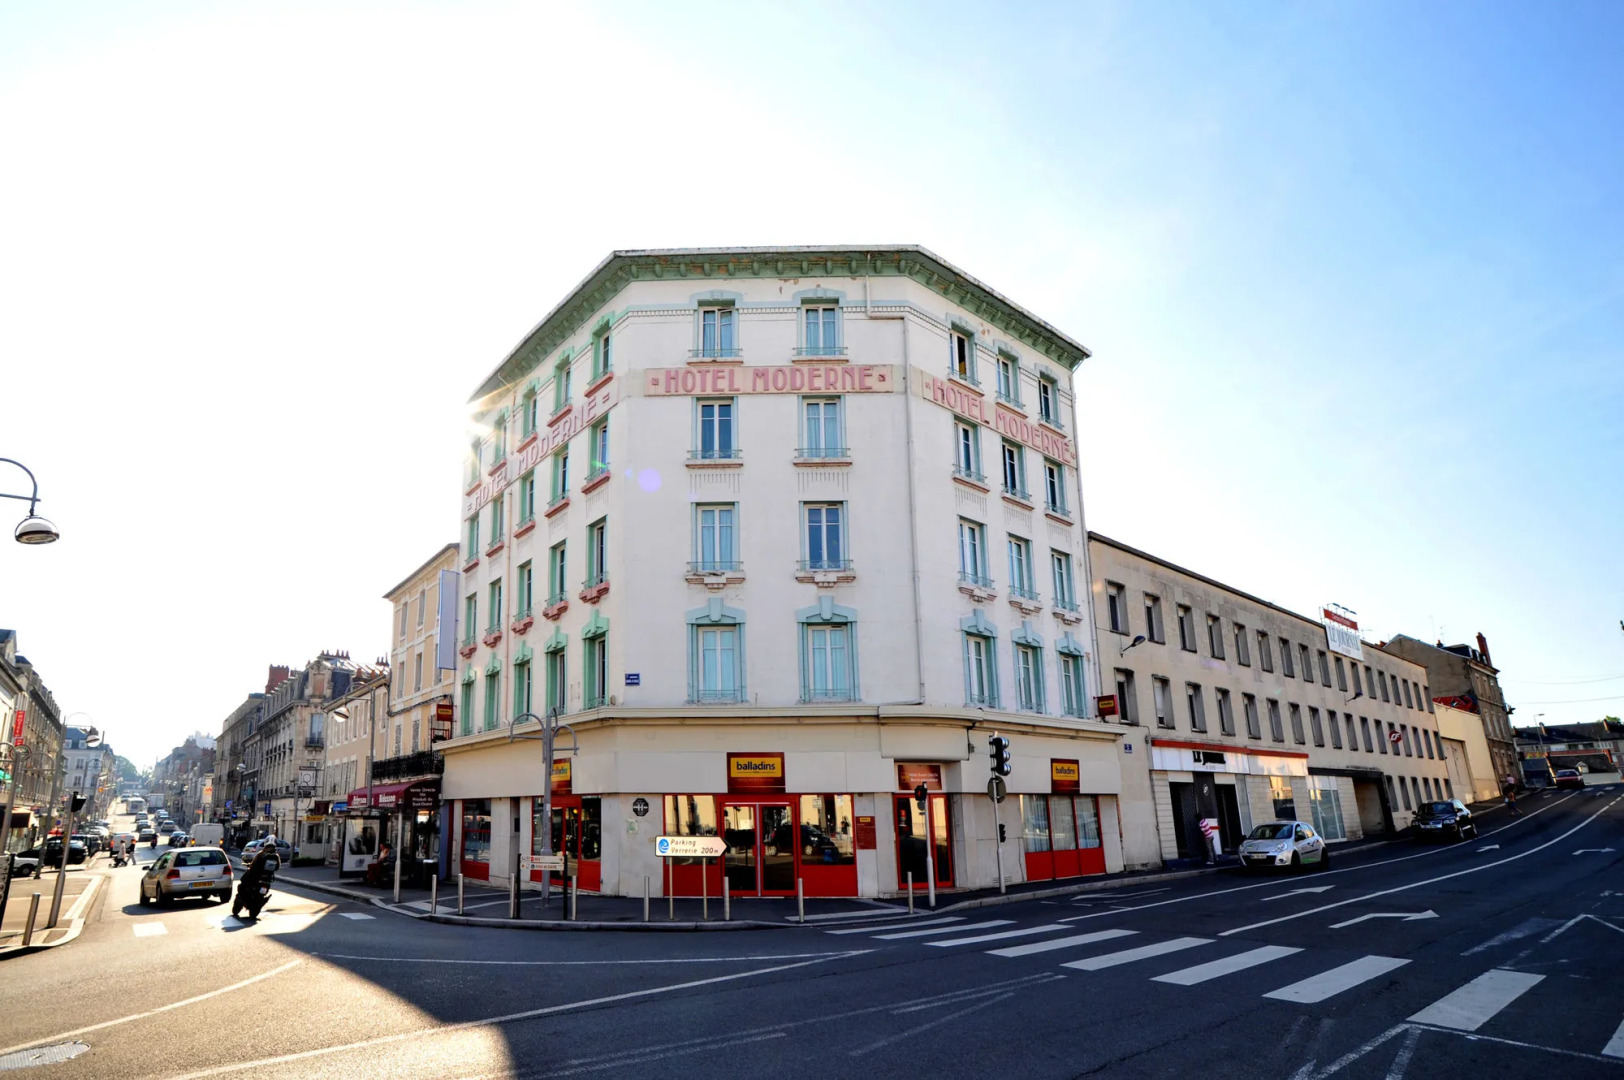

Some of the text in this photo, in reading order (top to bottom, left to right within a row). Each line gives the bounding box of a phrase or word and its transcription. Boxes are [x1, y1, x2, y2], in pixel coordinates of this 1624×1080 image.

[664, 365, 873, 393] HOTEL MODERNE
[932, 377, 1072, 464] HOTEL MODERNE
[517, 396, 597, 476] MODERNE
[736, 760, 776, 771] balladins
[1055, 765, 1076, 775] balladins
[670, 838, 697, 847] Parking
[700, 846, 714, 855] 200
